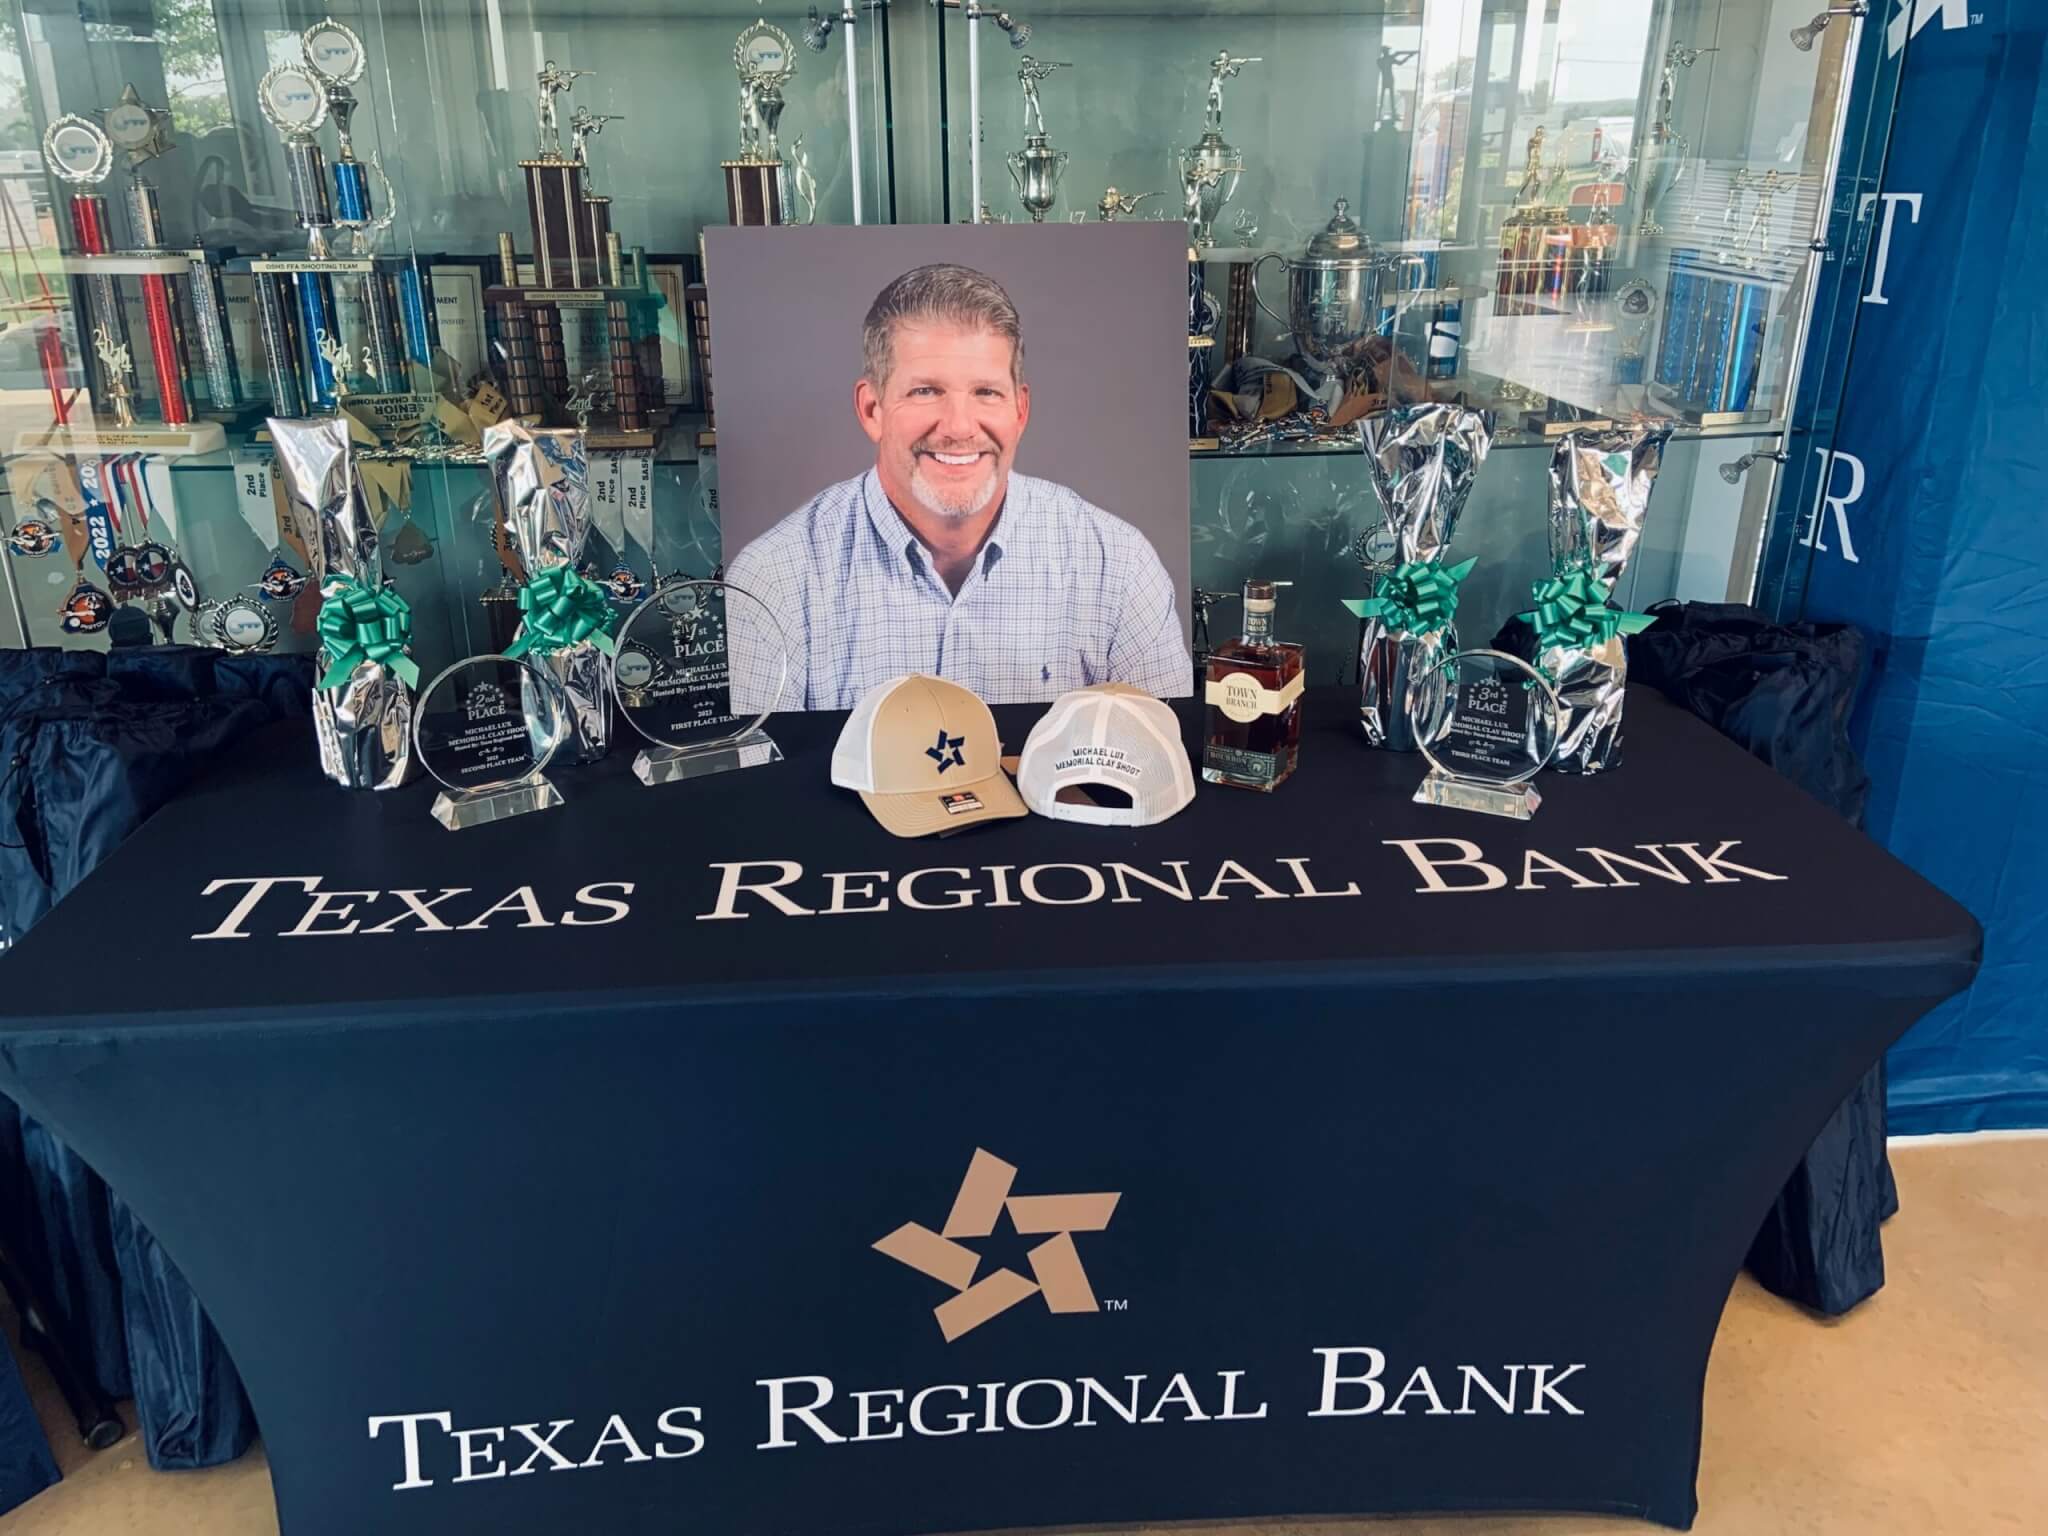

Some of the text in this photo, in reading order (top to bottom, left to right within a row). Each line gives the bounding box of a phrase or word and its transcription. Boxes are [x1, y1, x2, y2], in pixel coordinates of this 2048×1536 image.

[1856, 192, 1923, 305] T
[374, 403, 425, 415] SENIOR
[384, 413, 420, 422] PISTOL
[244, 474, 257, 496] 2nd
[597, 481, 606, 502] 2nd
[628, 487, 637, 508] 2nd
[1799, 446, 1866, 564] R
[89, 516, 111, 560] 2022
[675, 640, 725, 659] PLACE
[676, 664, 711, 676] MICHAEL
[711, 662, 727, 670] LUX
[657, 676, 700, 688] MEMORIAL
[700, 673, 719, 681] CLAY
[653, 688, 675, 698] Hosted
[688, 684, 706, 692] Texas
[1226, 685, 1257, 700] TOWN
[1478, 687, 1499, 700] 3rd
[475, 694, 496, 709] 2nd
[1226, 697, 1257, 710] BRANCH
[1468, 699, 1507, 714] PLACE
[468, 704, 506, 720] PLACE
[465, 721, 512, 736] MICHAEL LUX
[671, 714, 741, 731] FIRST PLACE TEAM
[1461, 715, 1509, 729] MICHAEL LUX
[448, 733, 488, 747] MEMORIAL
[488, 729, 507, 739] CLAY
[1482, 726, 1500, 736] CLAY
[1501, 730, 1526, 739] SHOOT
[1072, 747, 1124, 760] MICHAEL LUX
[1471, 753, 1490, 762] PLACE
[1492, 757, 1510, 766] TEAM
[486, 760, 507, 769] PLACE
[507, 756, 525, 765] TEAM
[1055, 758, 1141, 776] MEMORIAL CLAY SHOOT
[1104, 1299, 1128, 1311] TM
